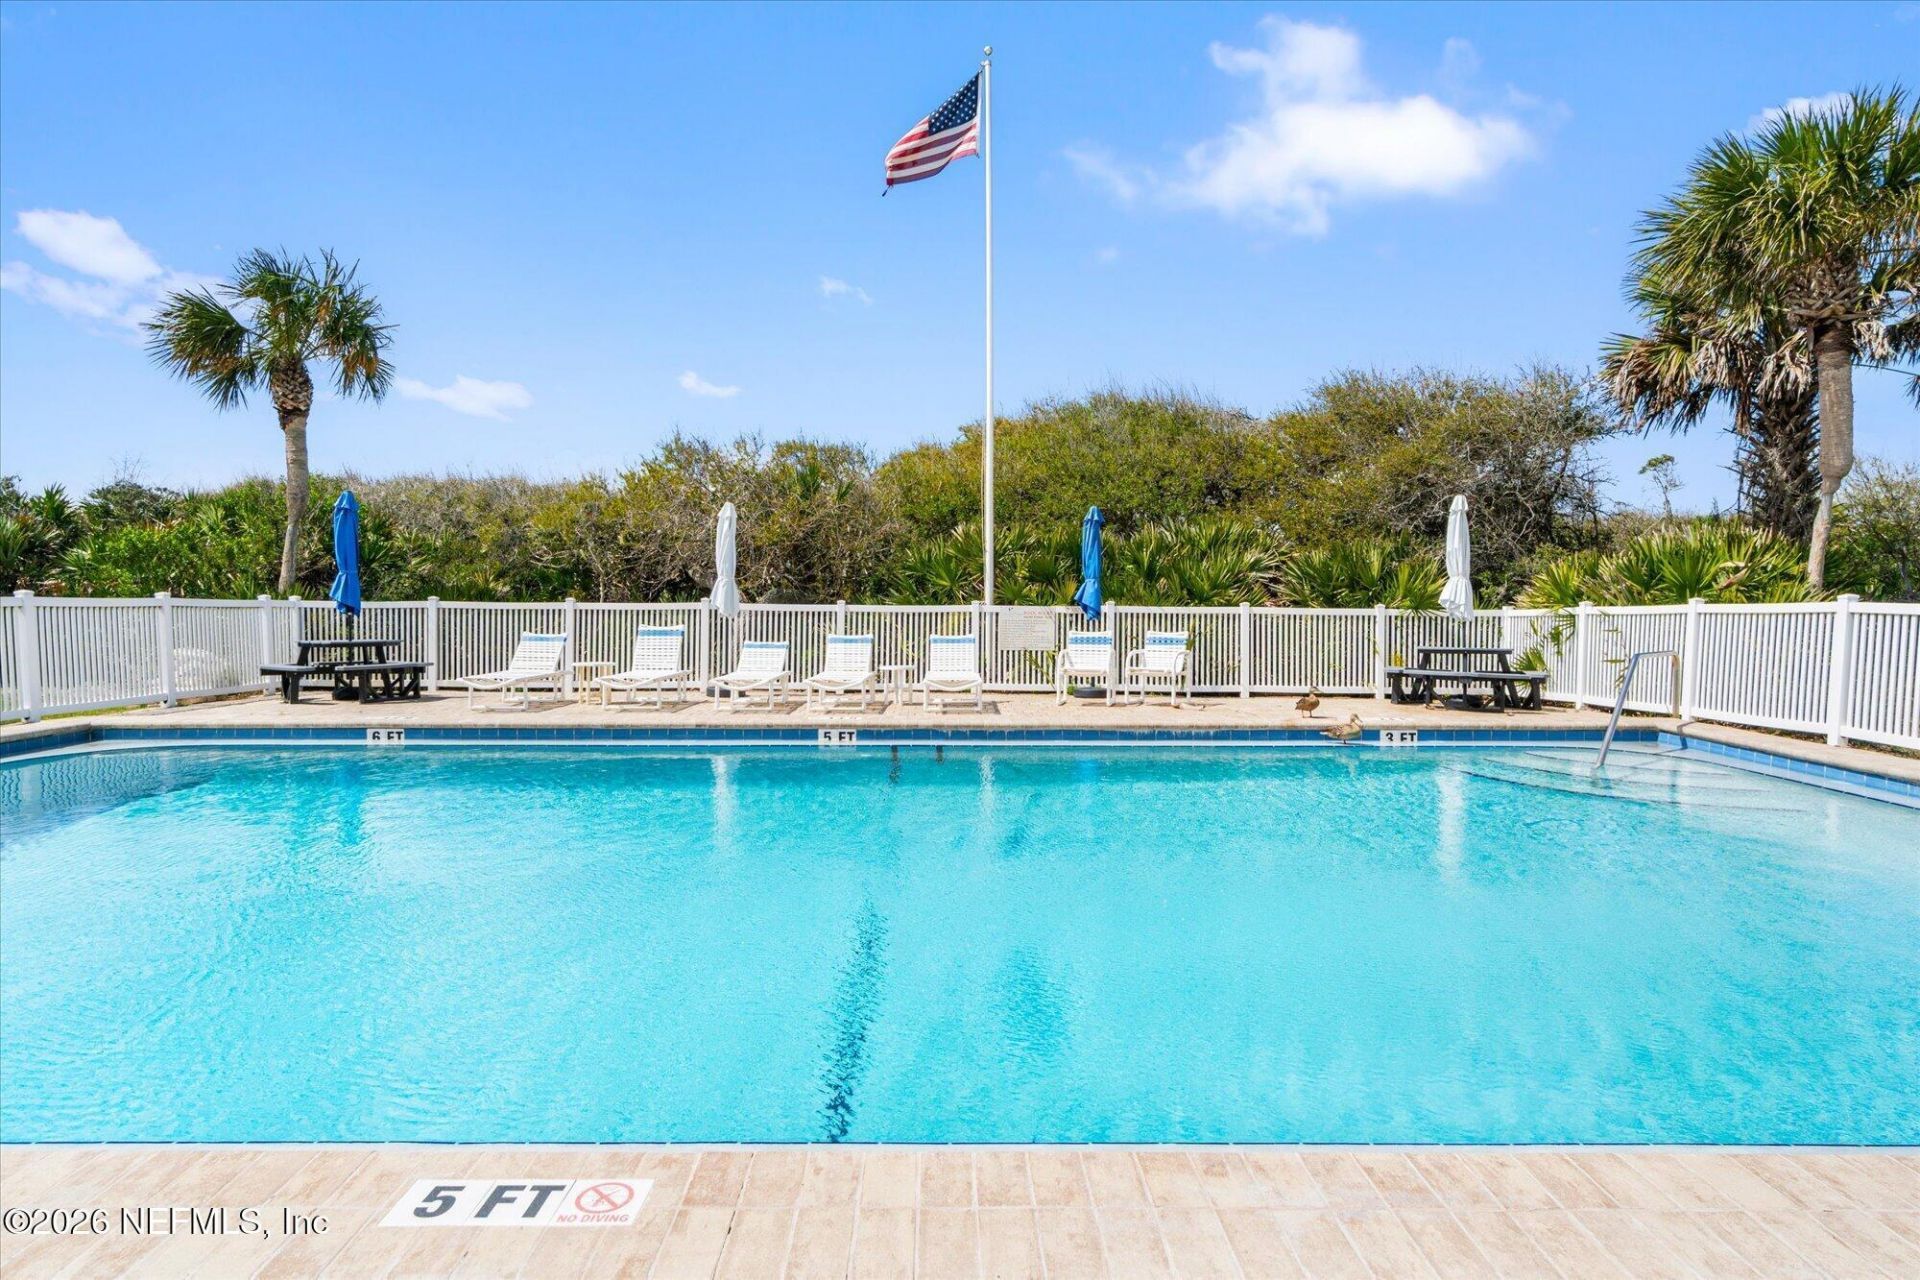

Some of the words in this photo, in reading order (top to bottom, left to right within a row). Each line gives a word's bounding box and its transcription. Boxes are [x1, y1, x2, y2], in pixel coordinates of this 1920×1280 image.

[372, 731, 381, 740] 6
[387, 731, 403, 740] FT
[824, 731, 832, 741] 5
[839, 731, 855, 741] FT
[1385, 732, 1394, 741] 3
[1400, 732, 1417, 741] FT
[413, 1186, 466, 1218] 5
[474, 1185, 567, 1218] FT
[556, 1214, 577, 1223] NO
[580, 1214, 629, 1223] DIVING
